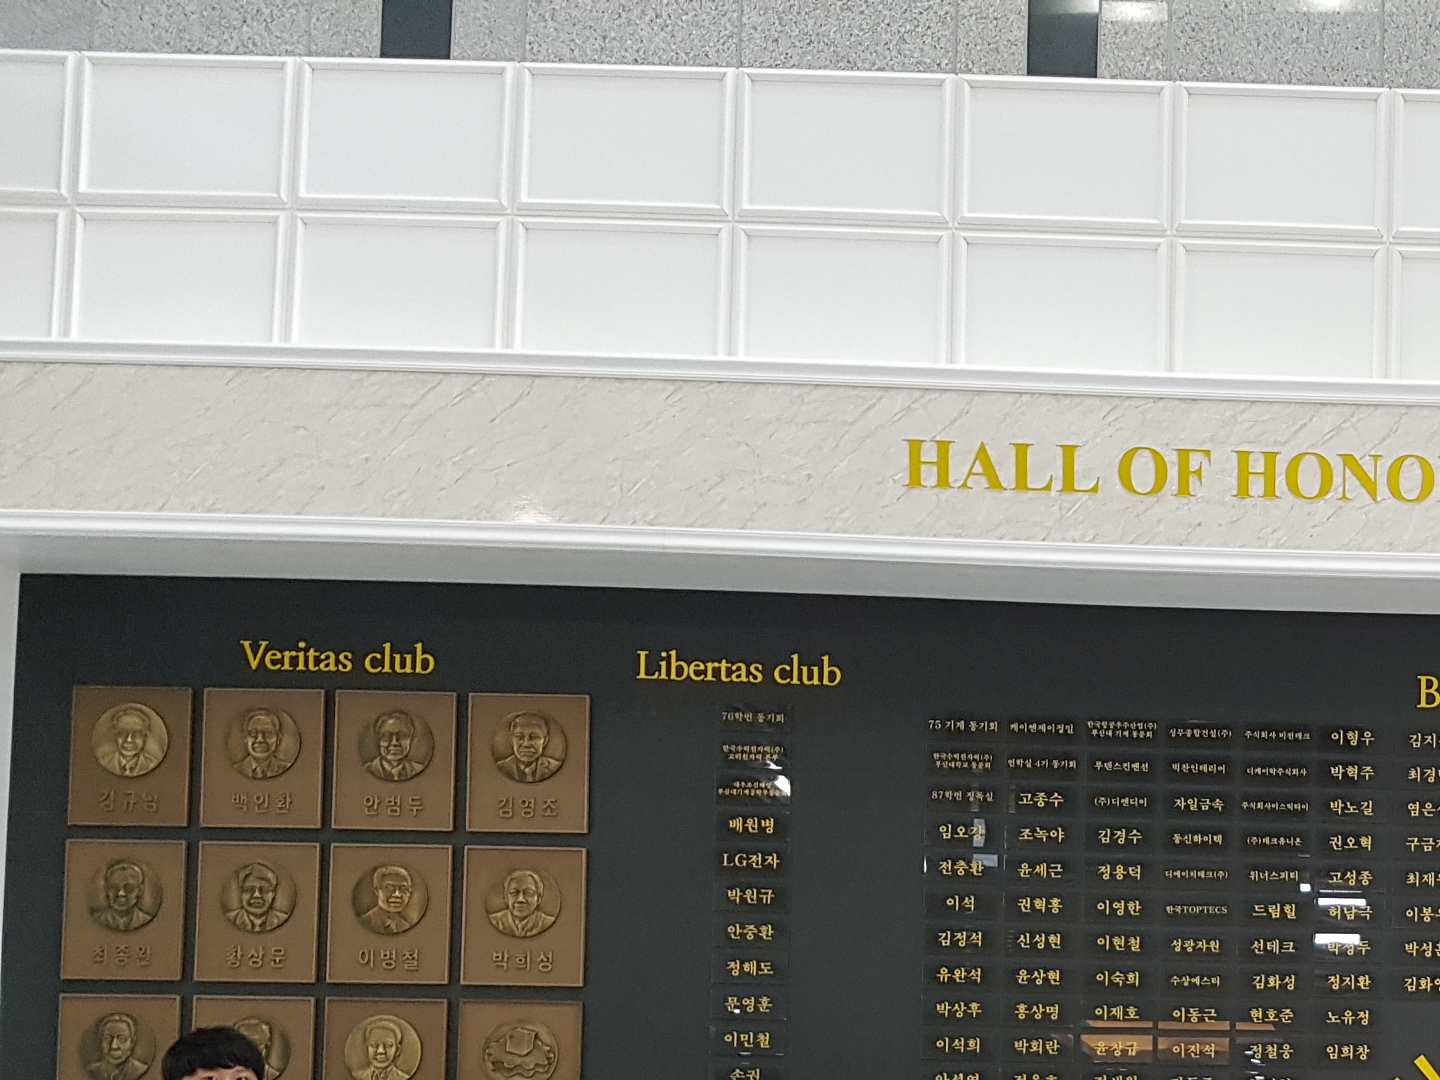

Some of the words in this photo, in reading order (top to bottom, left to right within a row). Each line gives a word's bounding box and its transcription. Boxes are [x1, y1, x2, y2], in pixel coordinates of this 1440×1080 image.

[902, 439, 1100, 494] HALL
[1117, 446, 1211, 498] OF
[241, 640, 353, 673] Veritas
[364, 643, 435, 675] club
[636, 650, 763, 684] Libertas
[773, 654, 842, 686] club
[928, 720, 941, 729] 75
[1331, 730, 1375, 746] 이형우
[1330, 765, 1375, 781] 박혁주
[498, 796, 559, 819] 김영조
[1018, 793, 1064, 808] 고종수
[1174, 797, 1225, 812] 자일금속
[1330, 800, 1374, 816] 박노길
[728, 817, 775, 834] 배원병
[1098, 829, 1143, 845] 김경수
[1329, 835, 1372, 851] 권오혁
[722, 853, 781, 869] LG전자
[938, 860, 984, 876] 전충환
[1017, 863, 1064, 878] 윤세근
[1097, 865, 1142, 881] 정용덕
[1328, 870, 1373, 886] 고성종
[727, 888, 775, 905] 박원규
[946, 895, 975, 911] 이석
[1097, 900, 1142, 916] 이영한
[1166, 905, 1228, 914] 한국TOPTECS
[727, 924, 775, 941] 안중환
[938, 931, 983, 947] 김정석
[1016, 933, 1062, 949] 신성현
[1097, 935, 1142, 952] 이현철
[1171, 939, 1220, 953] 성광자원
[1251, 939, 1296, 954] 선테크
[726, 960, 774, 977] 정해도
[936, 967, 982, 983] 유완석
[1015, 969, 1061, 985] 윤상현
[1096, 971, 1139, 987] 이숙희
[1252, 975, 1296, 991] 김화성
[1327, 974, 1371, 990] 정지환
[725, 996, 773, 1013] 문영훈
[936, 1002, 982, 1018] 박상후
[1014, 1004, 1060, 1020] 홍상명
[1095, 1005, 1140, 1021] 이재호
[1173, 1007, 1217, 1023] 이동근
[1250, 1008, 1294, 1024] 현호준
[1326, 1010, 1370, 1026] 노유정
[724, 1031, 771, 1049] 이민철
[936, 1037, 981, 1053] 이석희
[1172, 1043, 1216, 1058] 이진석
[1326, 1044, 1370, 1060] 임희창
